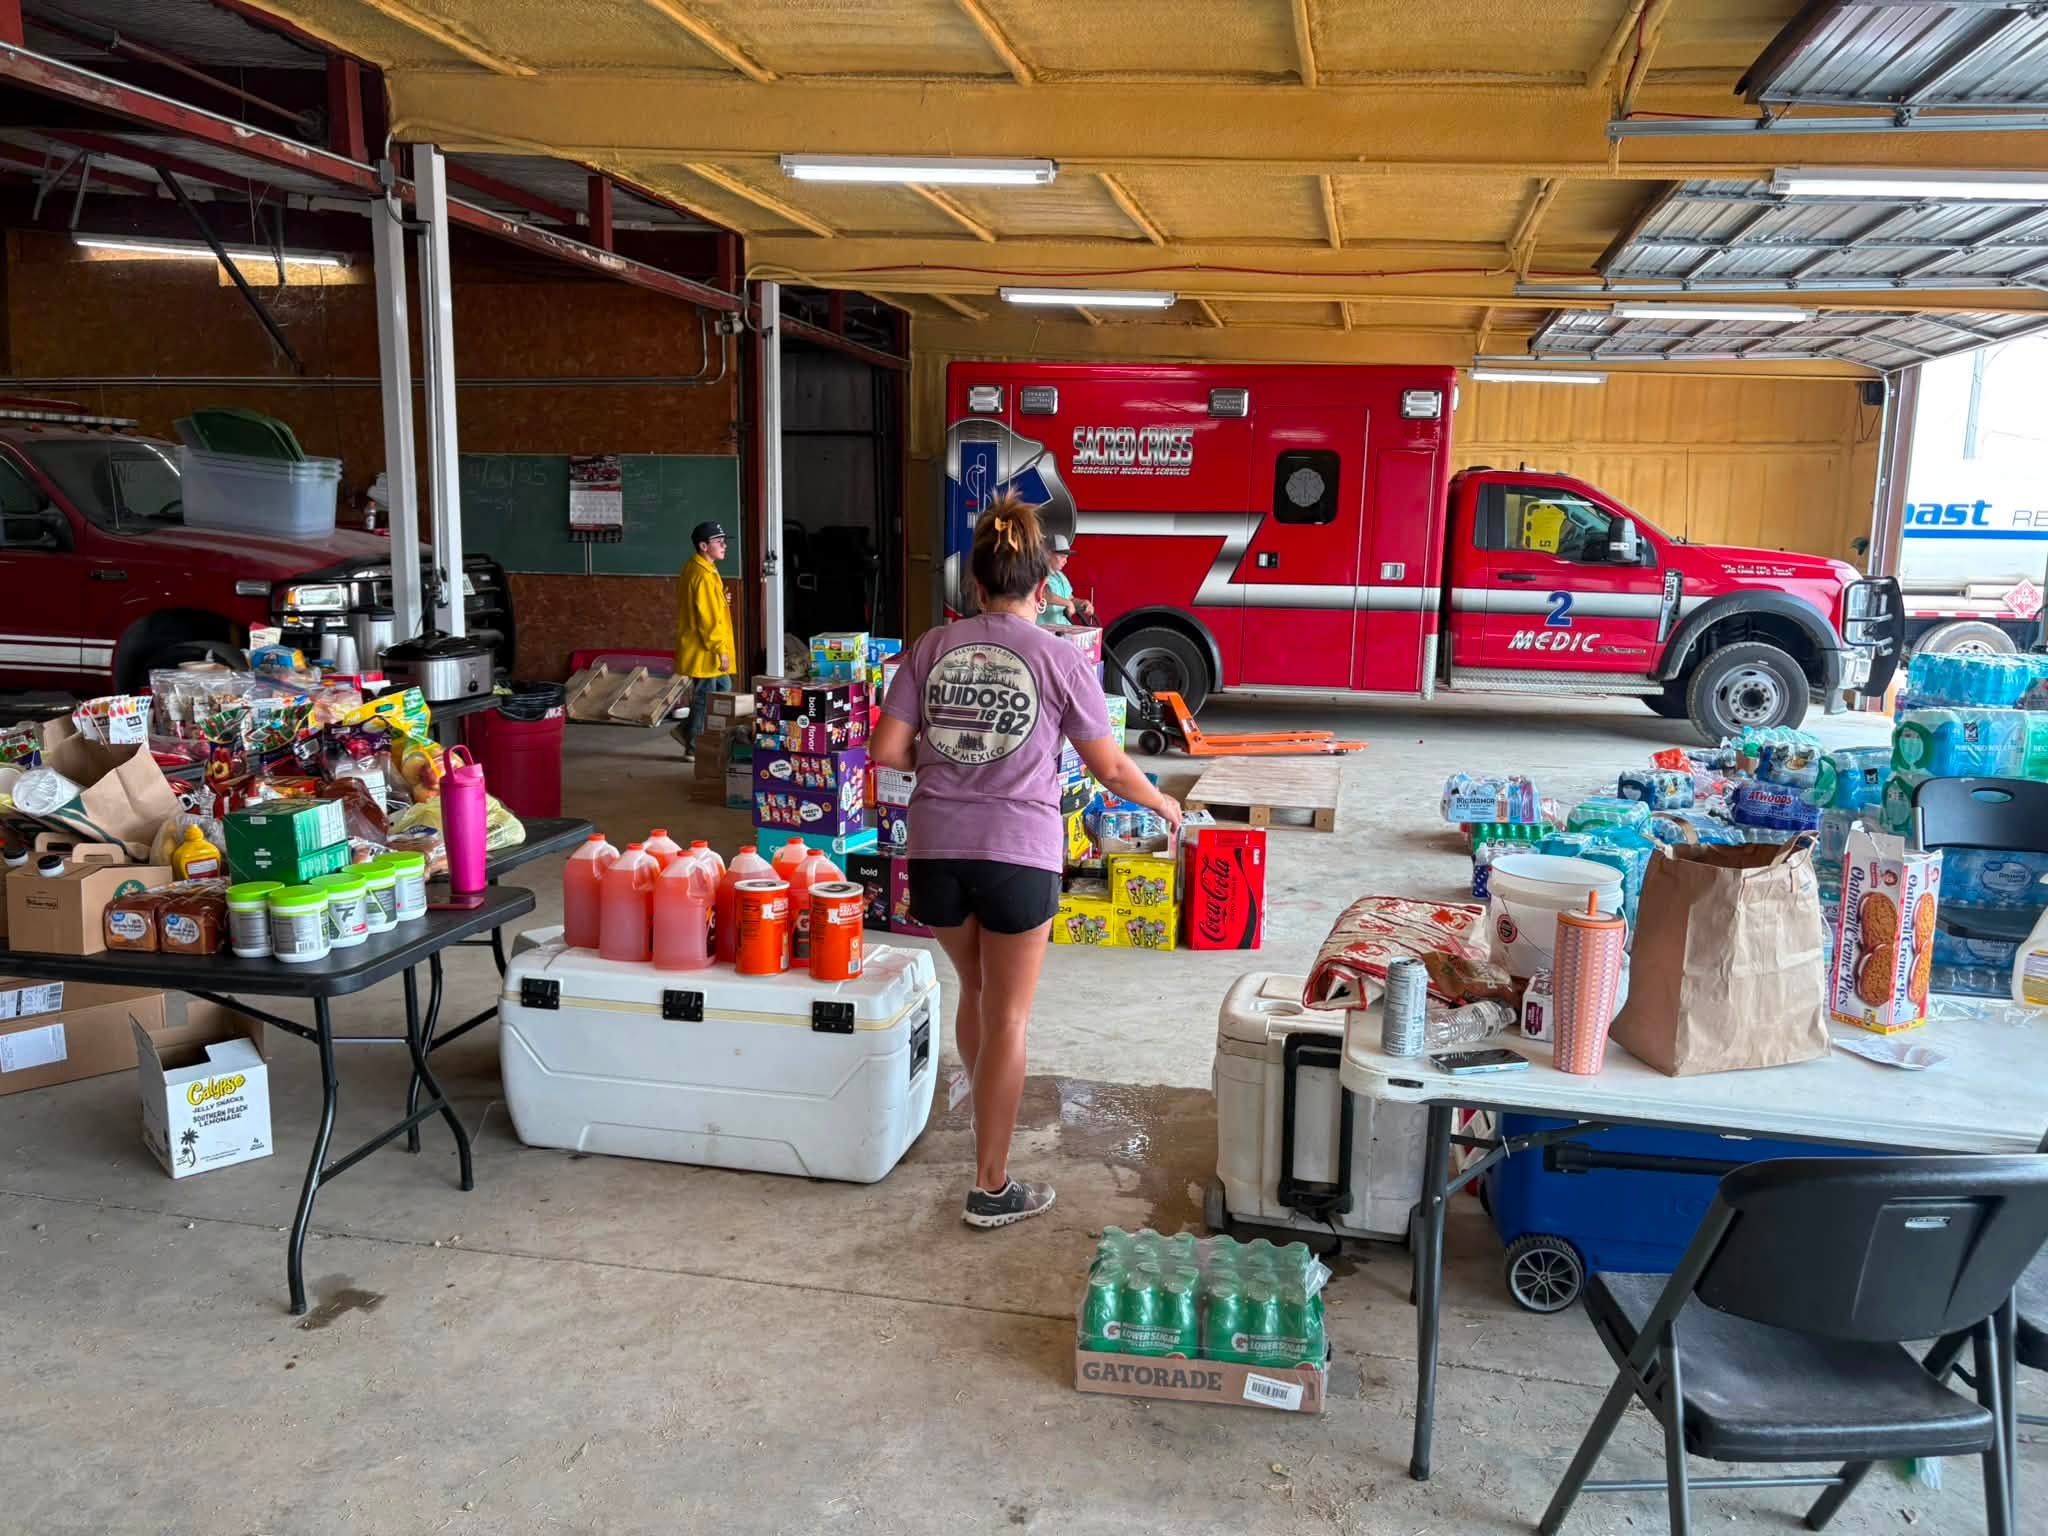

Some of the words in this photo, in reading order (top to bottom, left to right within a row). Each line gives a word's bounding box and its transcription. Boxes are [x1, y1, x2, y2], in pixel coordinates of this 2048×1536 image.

[1072, 427, 1136, 465] SACRED
[1137, 427, 1194, 466] CROSS
[1544, 590, 1574, 628] 2
[1507, 630, 1601, 654] MEDIC
[808, 696, 817, 717] bold
[929, 685, 1030, 711] RUIDOSO
[979, 709, 1031, 736] 1882
[807, 724, 817, 753] flavor
[936, 741, 961, 756] NEW
[960, 746, 1006, 763] MEXICO
[1747, 791, 1793, 805] ATWOODS
[860, 867, 878, 878] bold
[1116, 867, 1131, 875] C4
[1846, 866, 1865, 927] Oatmeal
[1902, 874, 1918, 935] Oatmeal
[1842, 926, 1860, 971] Creme
[1897, 933, 1913, 980] Creme
[1838, 973, 1854, 1008] Pies
[1894, 982, 1905, 1017] Pies
[187, 1074, 246, 1106] Calypso
[192, 1104, 215, 1113] JELLY
[216, 1096, 244, 1107] SNACKS
[193, 1110, 226, 1123] SOUTHERN
[227, 1104, 248, 1114] PEACH
[199, 1113, 242, 1128] LEMONADE
[1121, 1329, 1151, 1342] LOWER
[1150, 1331, 1181, 1345] SUGAR
[1249, 1340, 1278, 1352] LOWER
[1082, 1361, 1224, 1392] GATORADE
